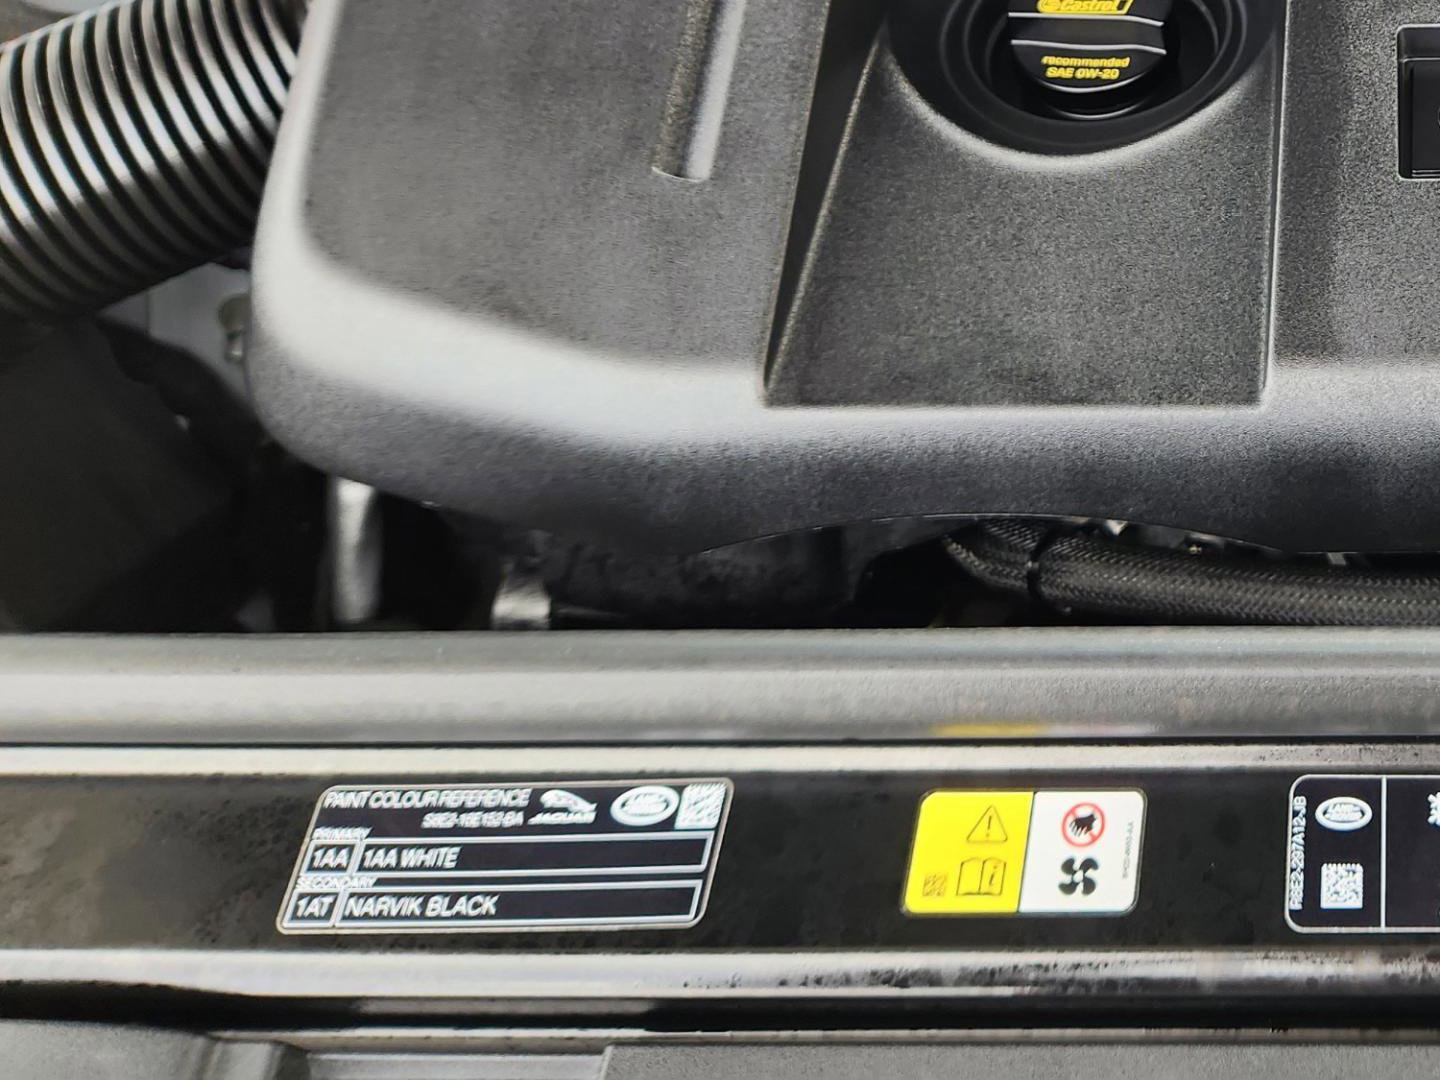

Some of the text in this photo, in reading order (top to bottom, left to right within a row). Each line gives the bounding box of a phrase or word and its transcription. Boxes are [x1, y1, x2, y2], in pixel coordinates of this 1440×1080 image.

[1041, 56, 1130, 67] recommended
[1046, 67, 1120, 79] SAE 0W-20
[323, 789, 532, 808] PAINT COLOUR REFERENCE
[312, 847, 350, 868] 1AA
[362, 847, 463, 868] 1AA WHITE
[297, 895, 335, 917] 1AT
[344, 894, 500, 917] NARVIK BLACK
